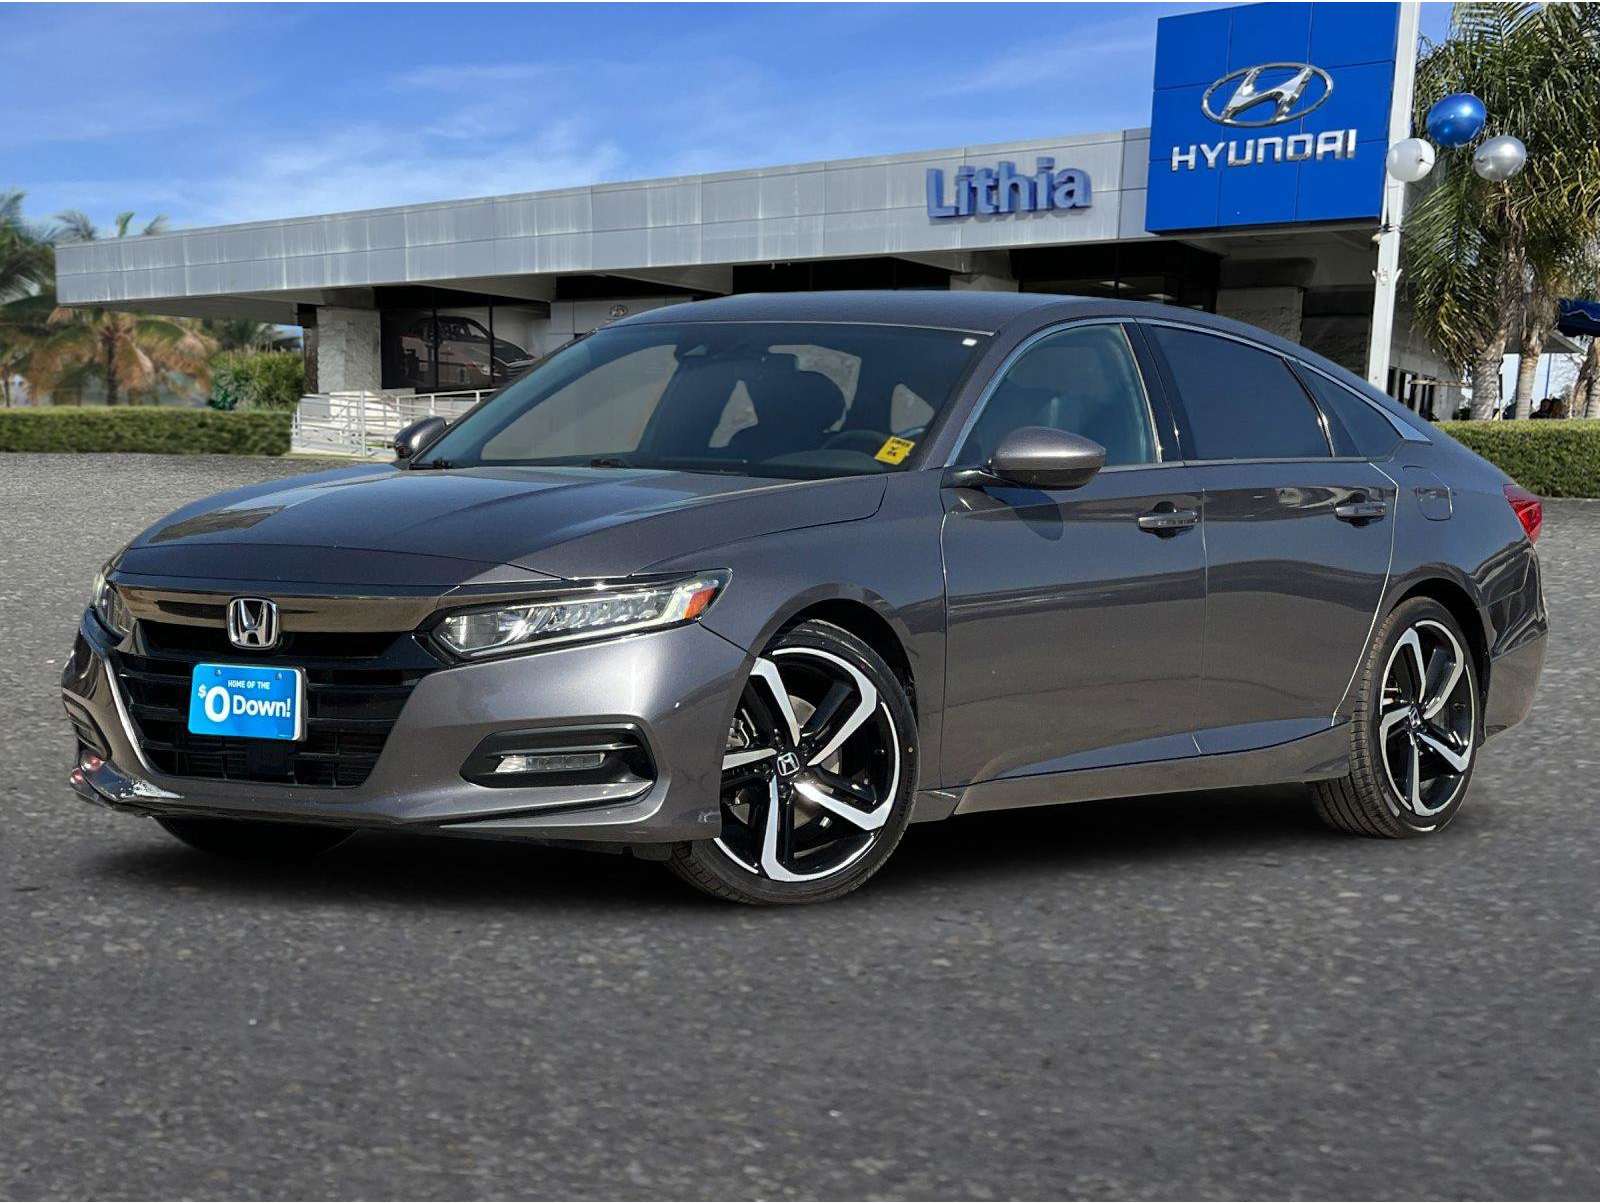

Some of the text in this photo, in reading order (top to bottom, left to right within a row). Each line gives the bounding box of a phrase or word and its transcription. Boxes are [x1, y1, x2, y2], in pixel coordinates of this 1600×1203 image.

[1171, 128, 1357, 172] HYUNDAI
[926, 156, 1093, 218] Lithia
[227, 680, 271, 690] HOME OF THE
[232, 694, 292, 718] Down!
